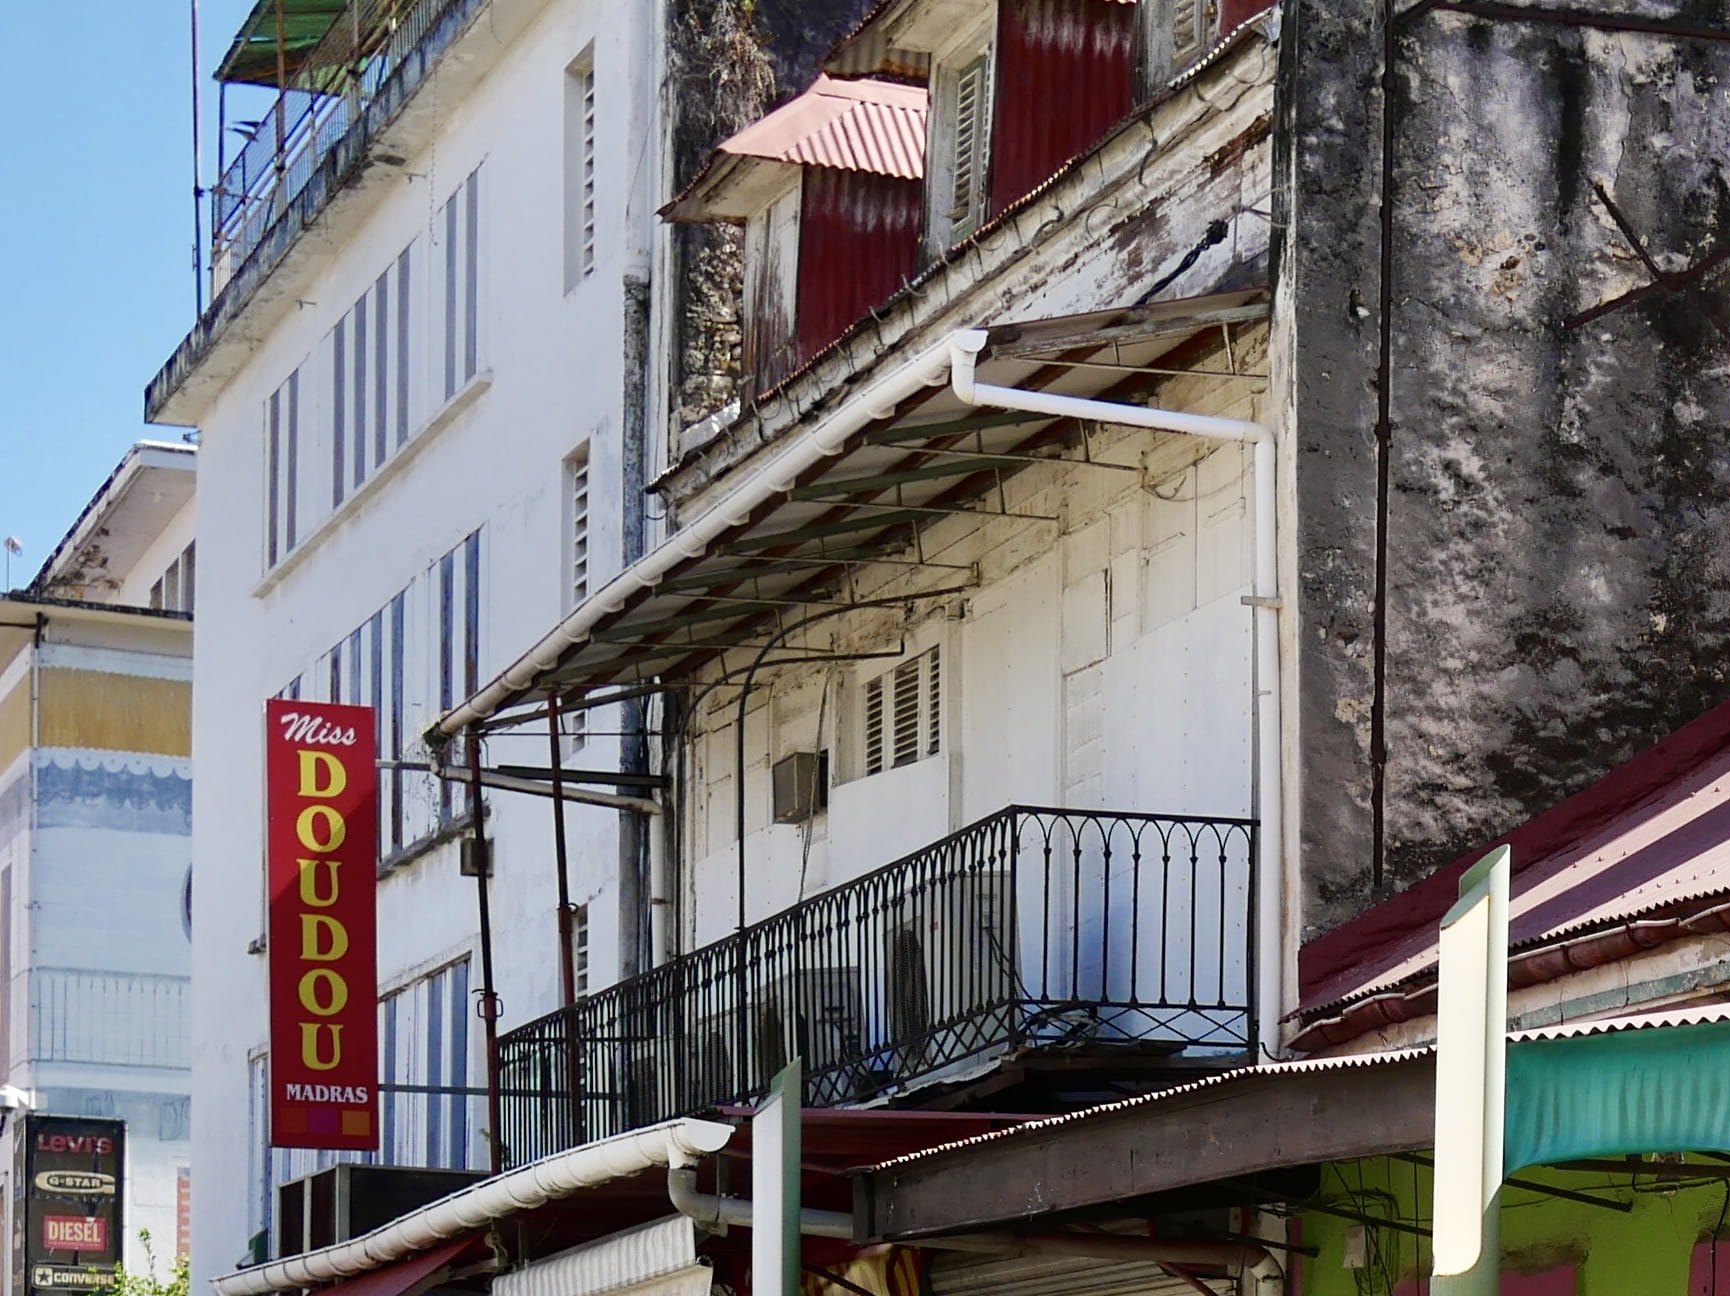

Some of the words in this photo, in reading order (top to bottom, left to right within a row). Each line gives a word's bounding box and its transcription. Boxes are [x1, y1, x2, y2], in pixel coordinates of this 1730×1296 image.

[281, 711, 358, 746] Miss
[296, 750, 349, 1070] DOUDOU
[286, 1083, 368, 1104] MADRAS
[48, 1220, 102, 1242] DIESEL
